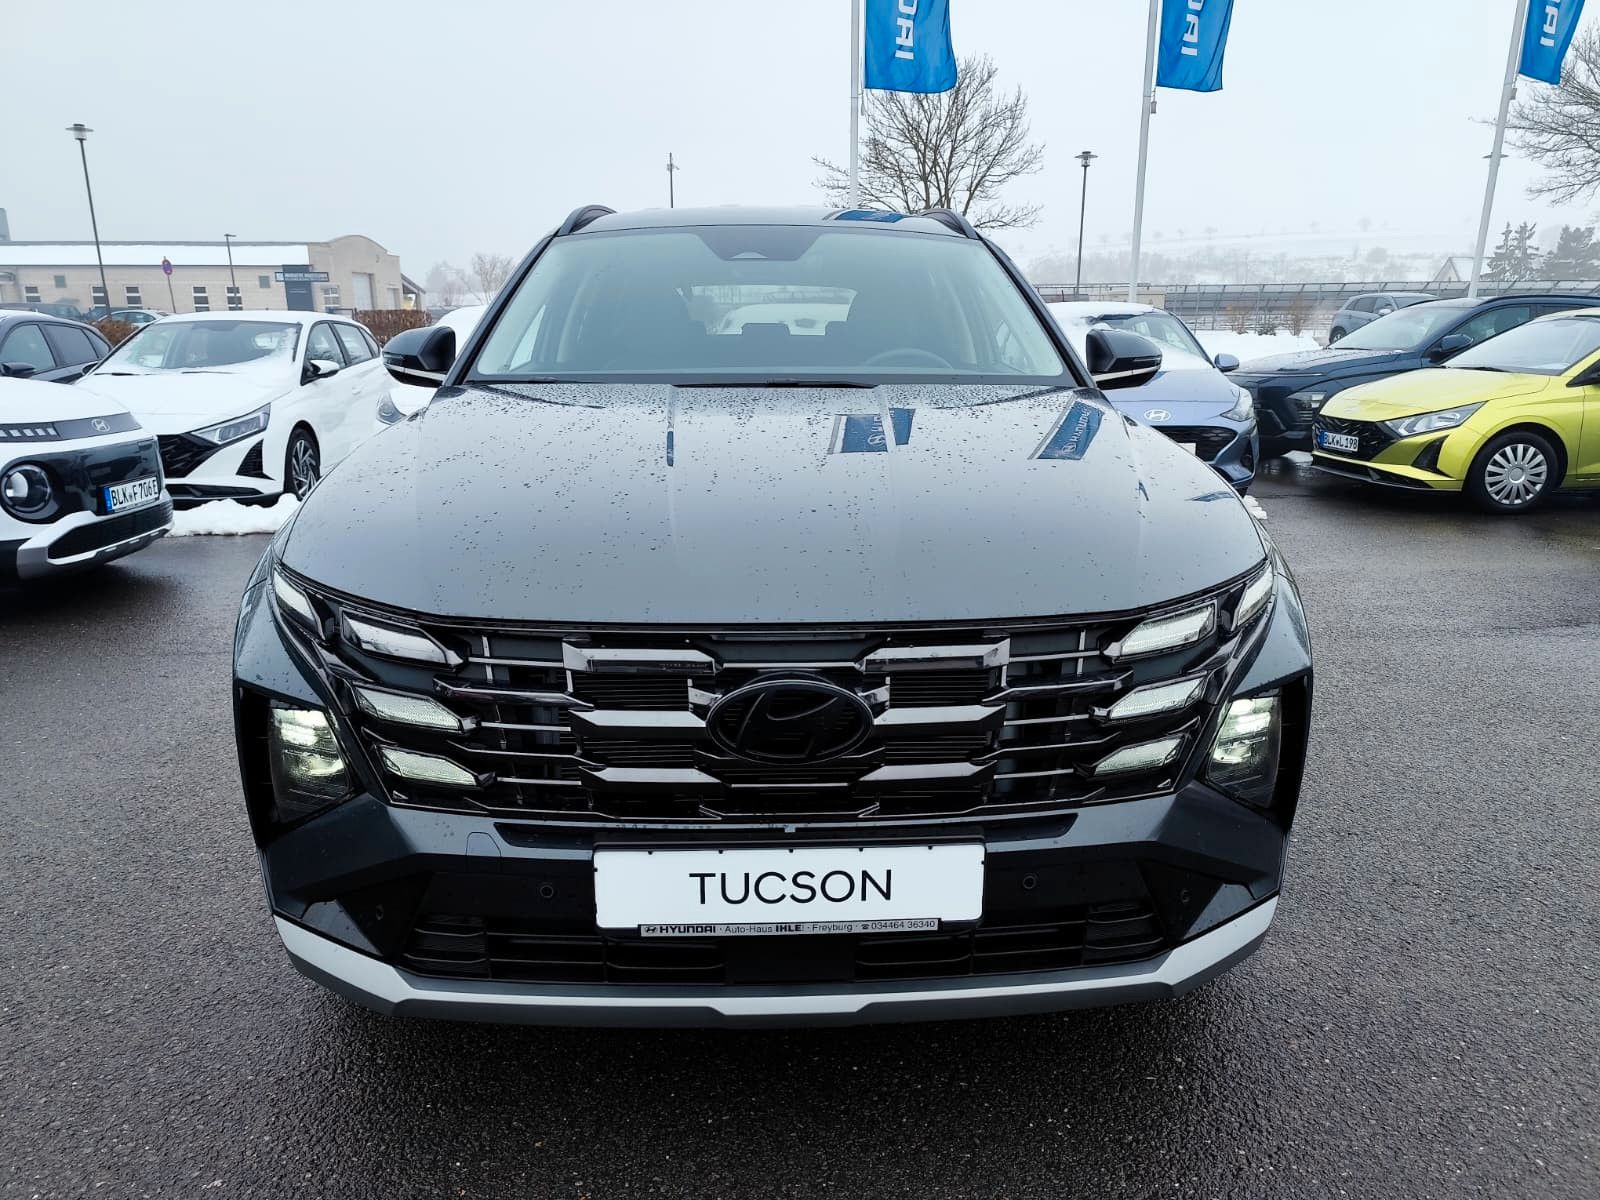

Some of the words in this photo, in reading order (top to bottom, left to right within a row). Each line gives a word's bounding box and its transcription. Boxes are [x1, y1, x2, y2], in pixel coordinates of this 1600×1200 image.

[111, 486, 129, 506] BLK
[688, 869, 892, 905] TUCSON
[659, 925, 716, 934] HYUNDAI
[724, 925, 773, 934] Auto-Haus
[812, 923, 853, 933] Freyburg
[871, 921, 905, 931] 034464
[907, 920, 936, 929] 36340
